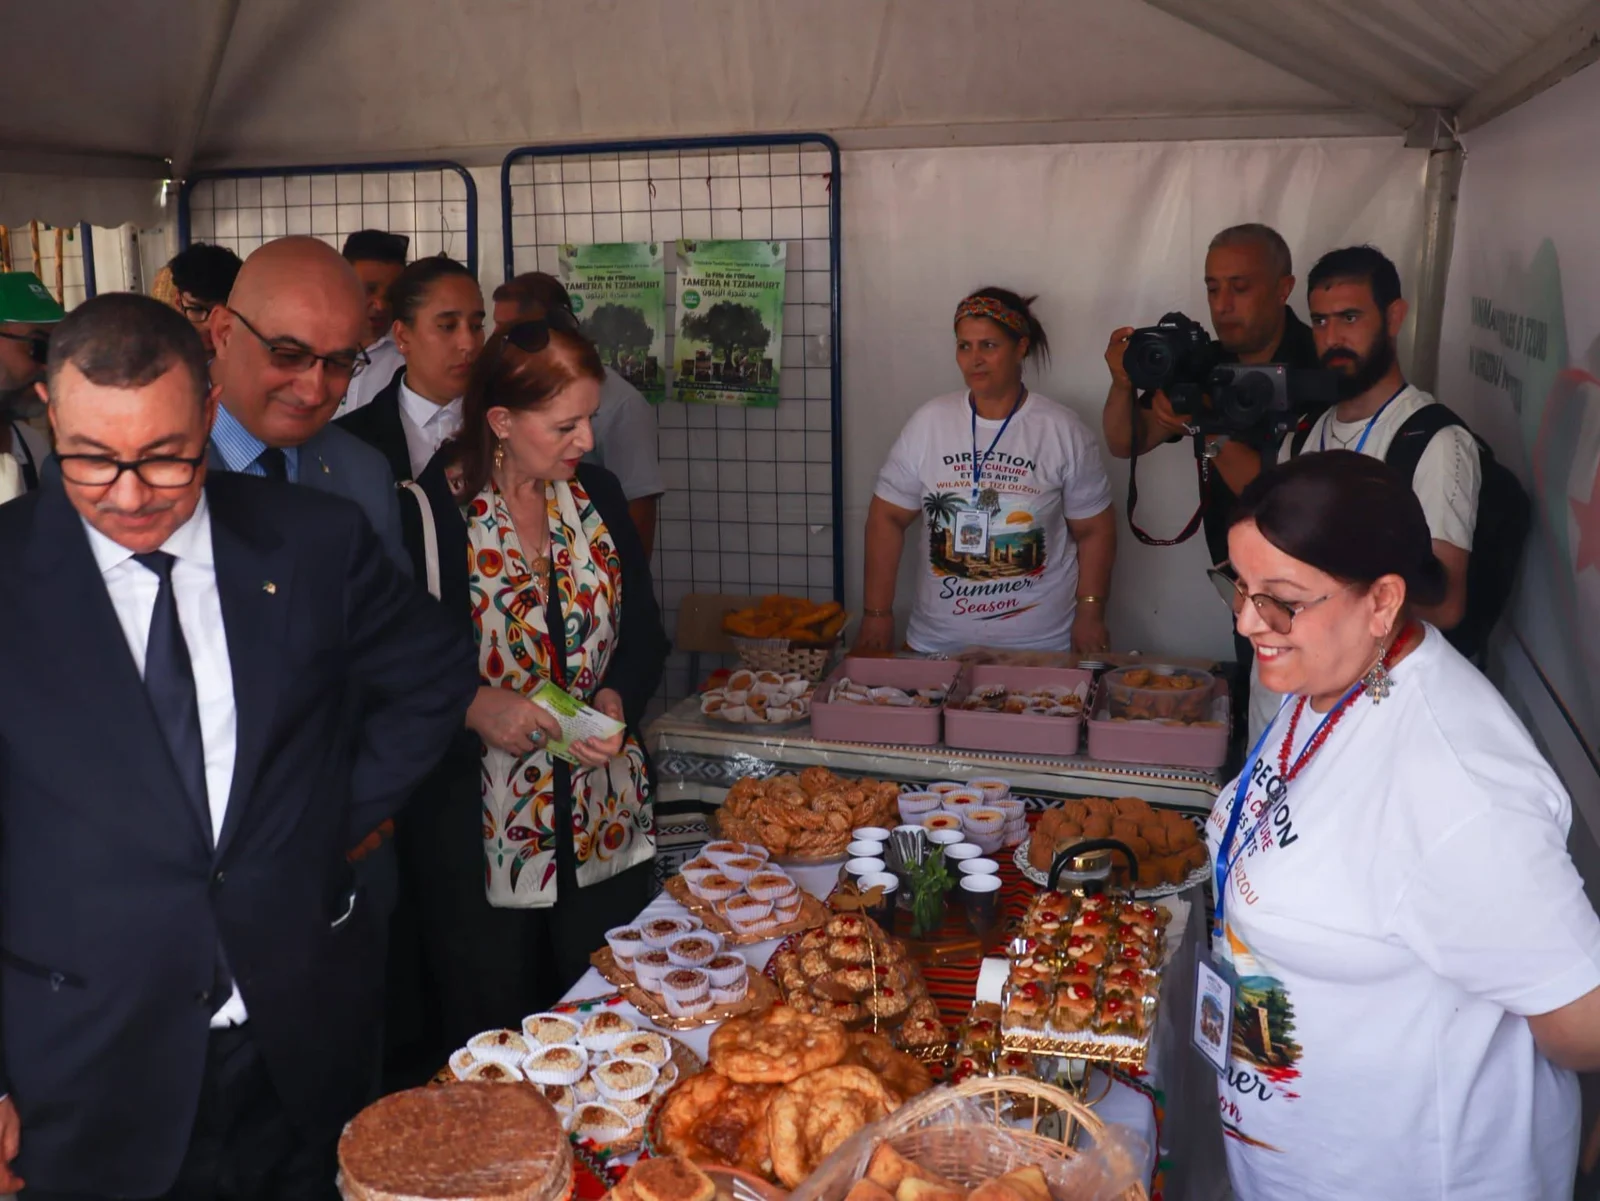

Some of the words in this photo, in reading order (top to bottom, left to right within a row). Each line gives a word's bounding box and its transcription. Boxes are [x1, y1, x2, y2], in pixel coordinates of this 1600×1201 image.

[605, 281, 612, 289] N
[615, 281, 660, 289] TZEMMURT
[732, 280, 780, 289] TZEMMURT
[702, 288, 725, 298] الزيتون
[727, 289, 747, 299] شجرة
[942, 449, 1036, 472] DIRECTION
[953, 464, 966, 472] DE
[985, 463, 1029, 477] CULTURE
[995, 474, 1018, 483] ARTS
[936, 480, 971, 489] WILAYA
[989, 481, 1006, 490] TIZI
[1007, 484, 1041, 495] OUZOU
[939, 576, 1031, 599] Summer
[952, 597, 1019, 616] Season
